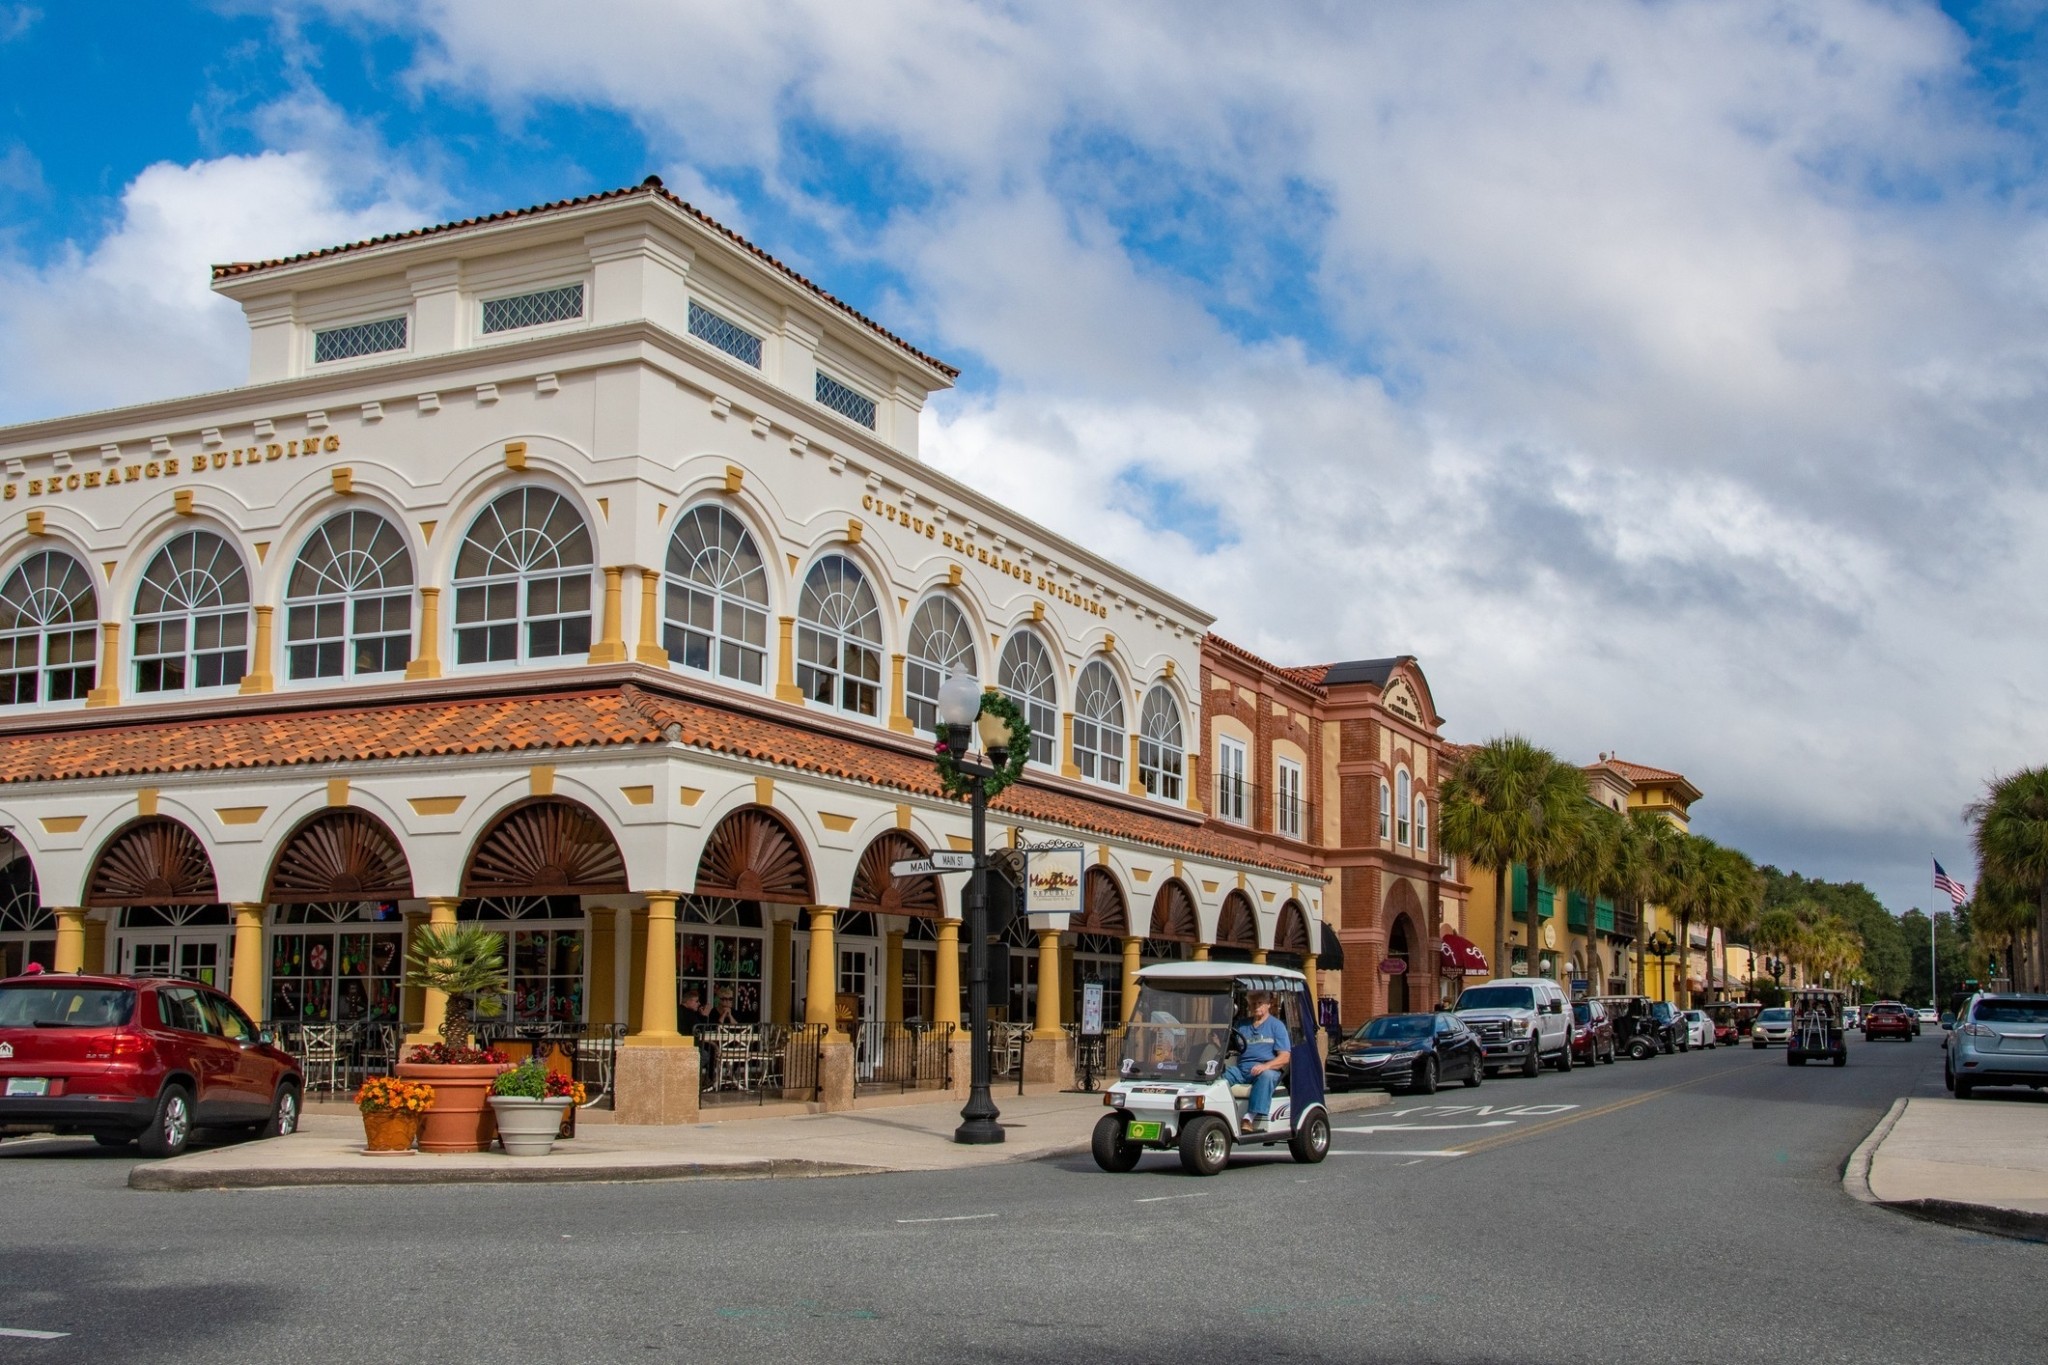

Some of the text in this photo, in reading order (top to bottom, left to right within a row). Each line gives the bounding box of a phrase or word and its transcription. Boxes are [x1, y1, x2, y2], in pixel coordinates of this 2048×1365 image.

[28, 458, 179, 496] EXCHANGE
[192, 434, 340, 471] BUILDING
[862, 494, 1108, 619] CITRUS EXCHANGE BUILDING
[910, 861, 933, 873] MAIN
[942, 855, 964, 867] MAIN ST
